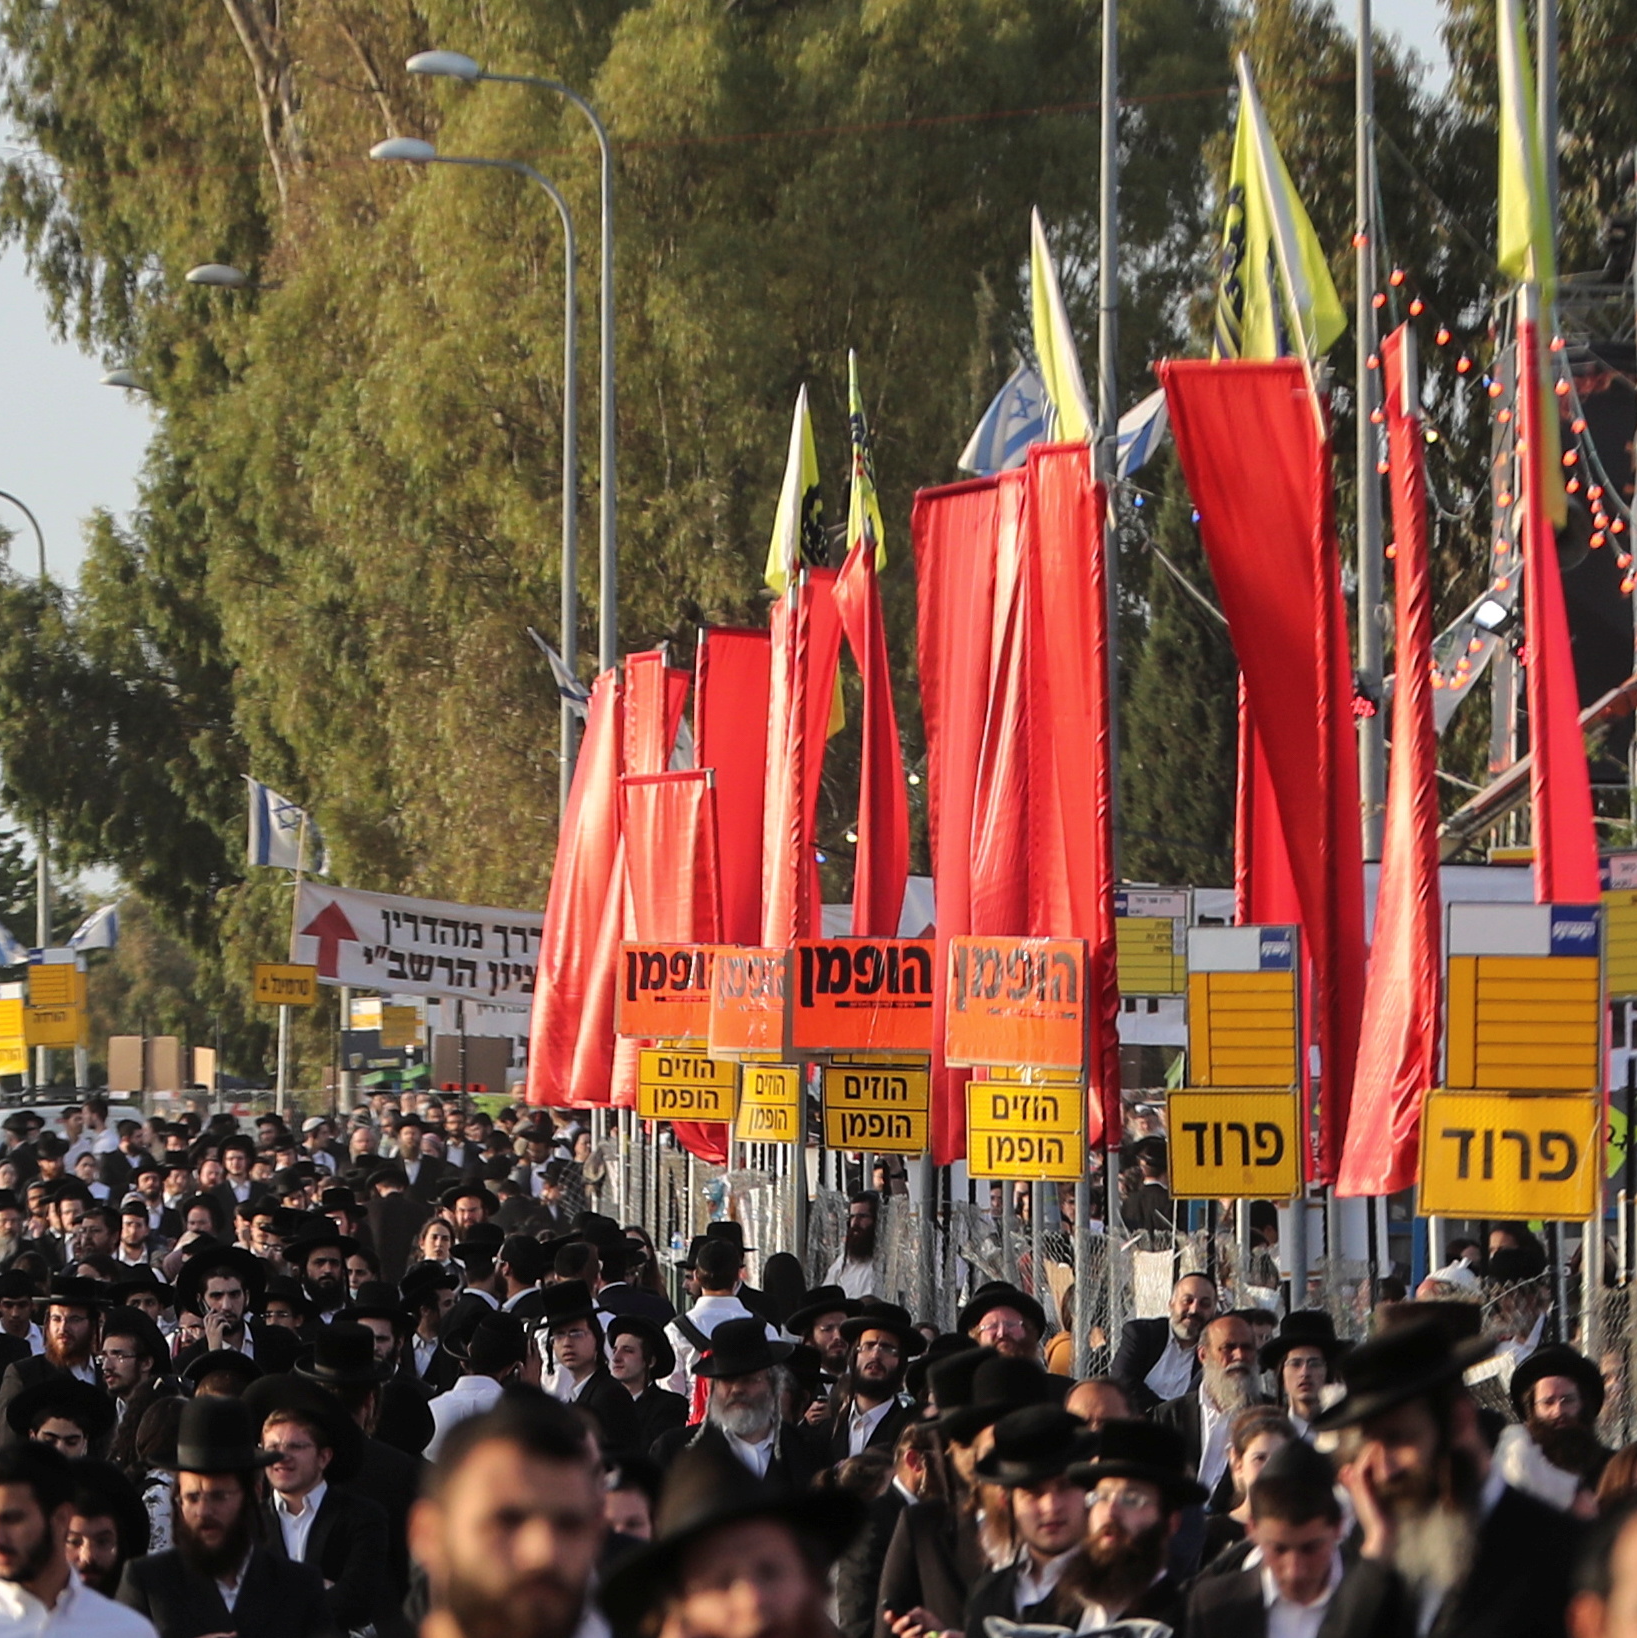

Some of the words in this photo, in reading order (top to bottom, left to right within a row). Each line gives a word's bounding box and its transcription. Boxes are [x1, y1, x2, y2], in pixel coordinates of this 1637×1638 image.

[381, 909, 483, 950] מהדרין
[626, 950, 711, 1001] ופמן
[799, 945, 932, 1009] הופמן
[953, 946, 1076, 1012] הופמן
[658, 1057, 716, 1079] הוזים
[755, 1074, 785, 1096] הוזים
[844, 1075, 908, 1101] הוזים
[653, 1089, 719, 1113] הופמן
[992, 1095, 1059, 1121] הוזים
[750, 1108, 787, 1134] הופמן
[841, 1113, 912, 1143] הופמן
[987, 1137, 1064, 1169] הופמן
[1182, 1122, 1285, 1167] פרוד
[1442, 1127, 1579, 1182] פרוד
